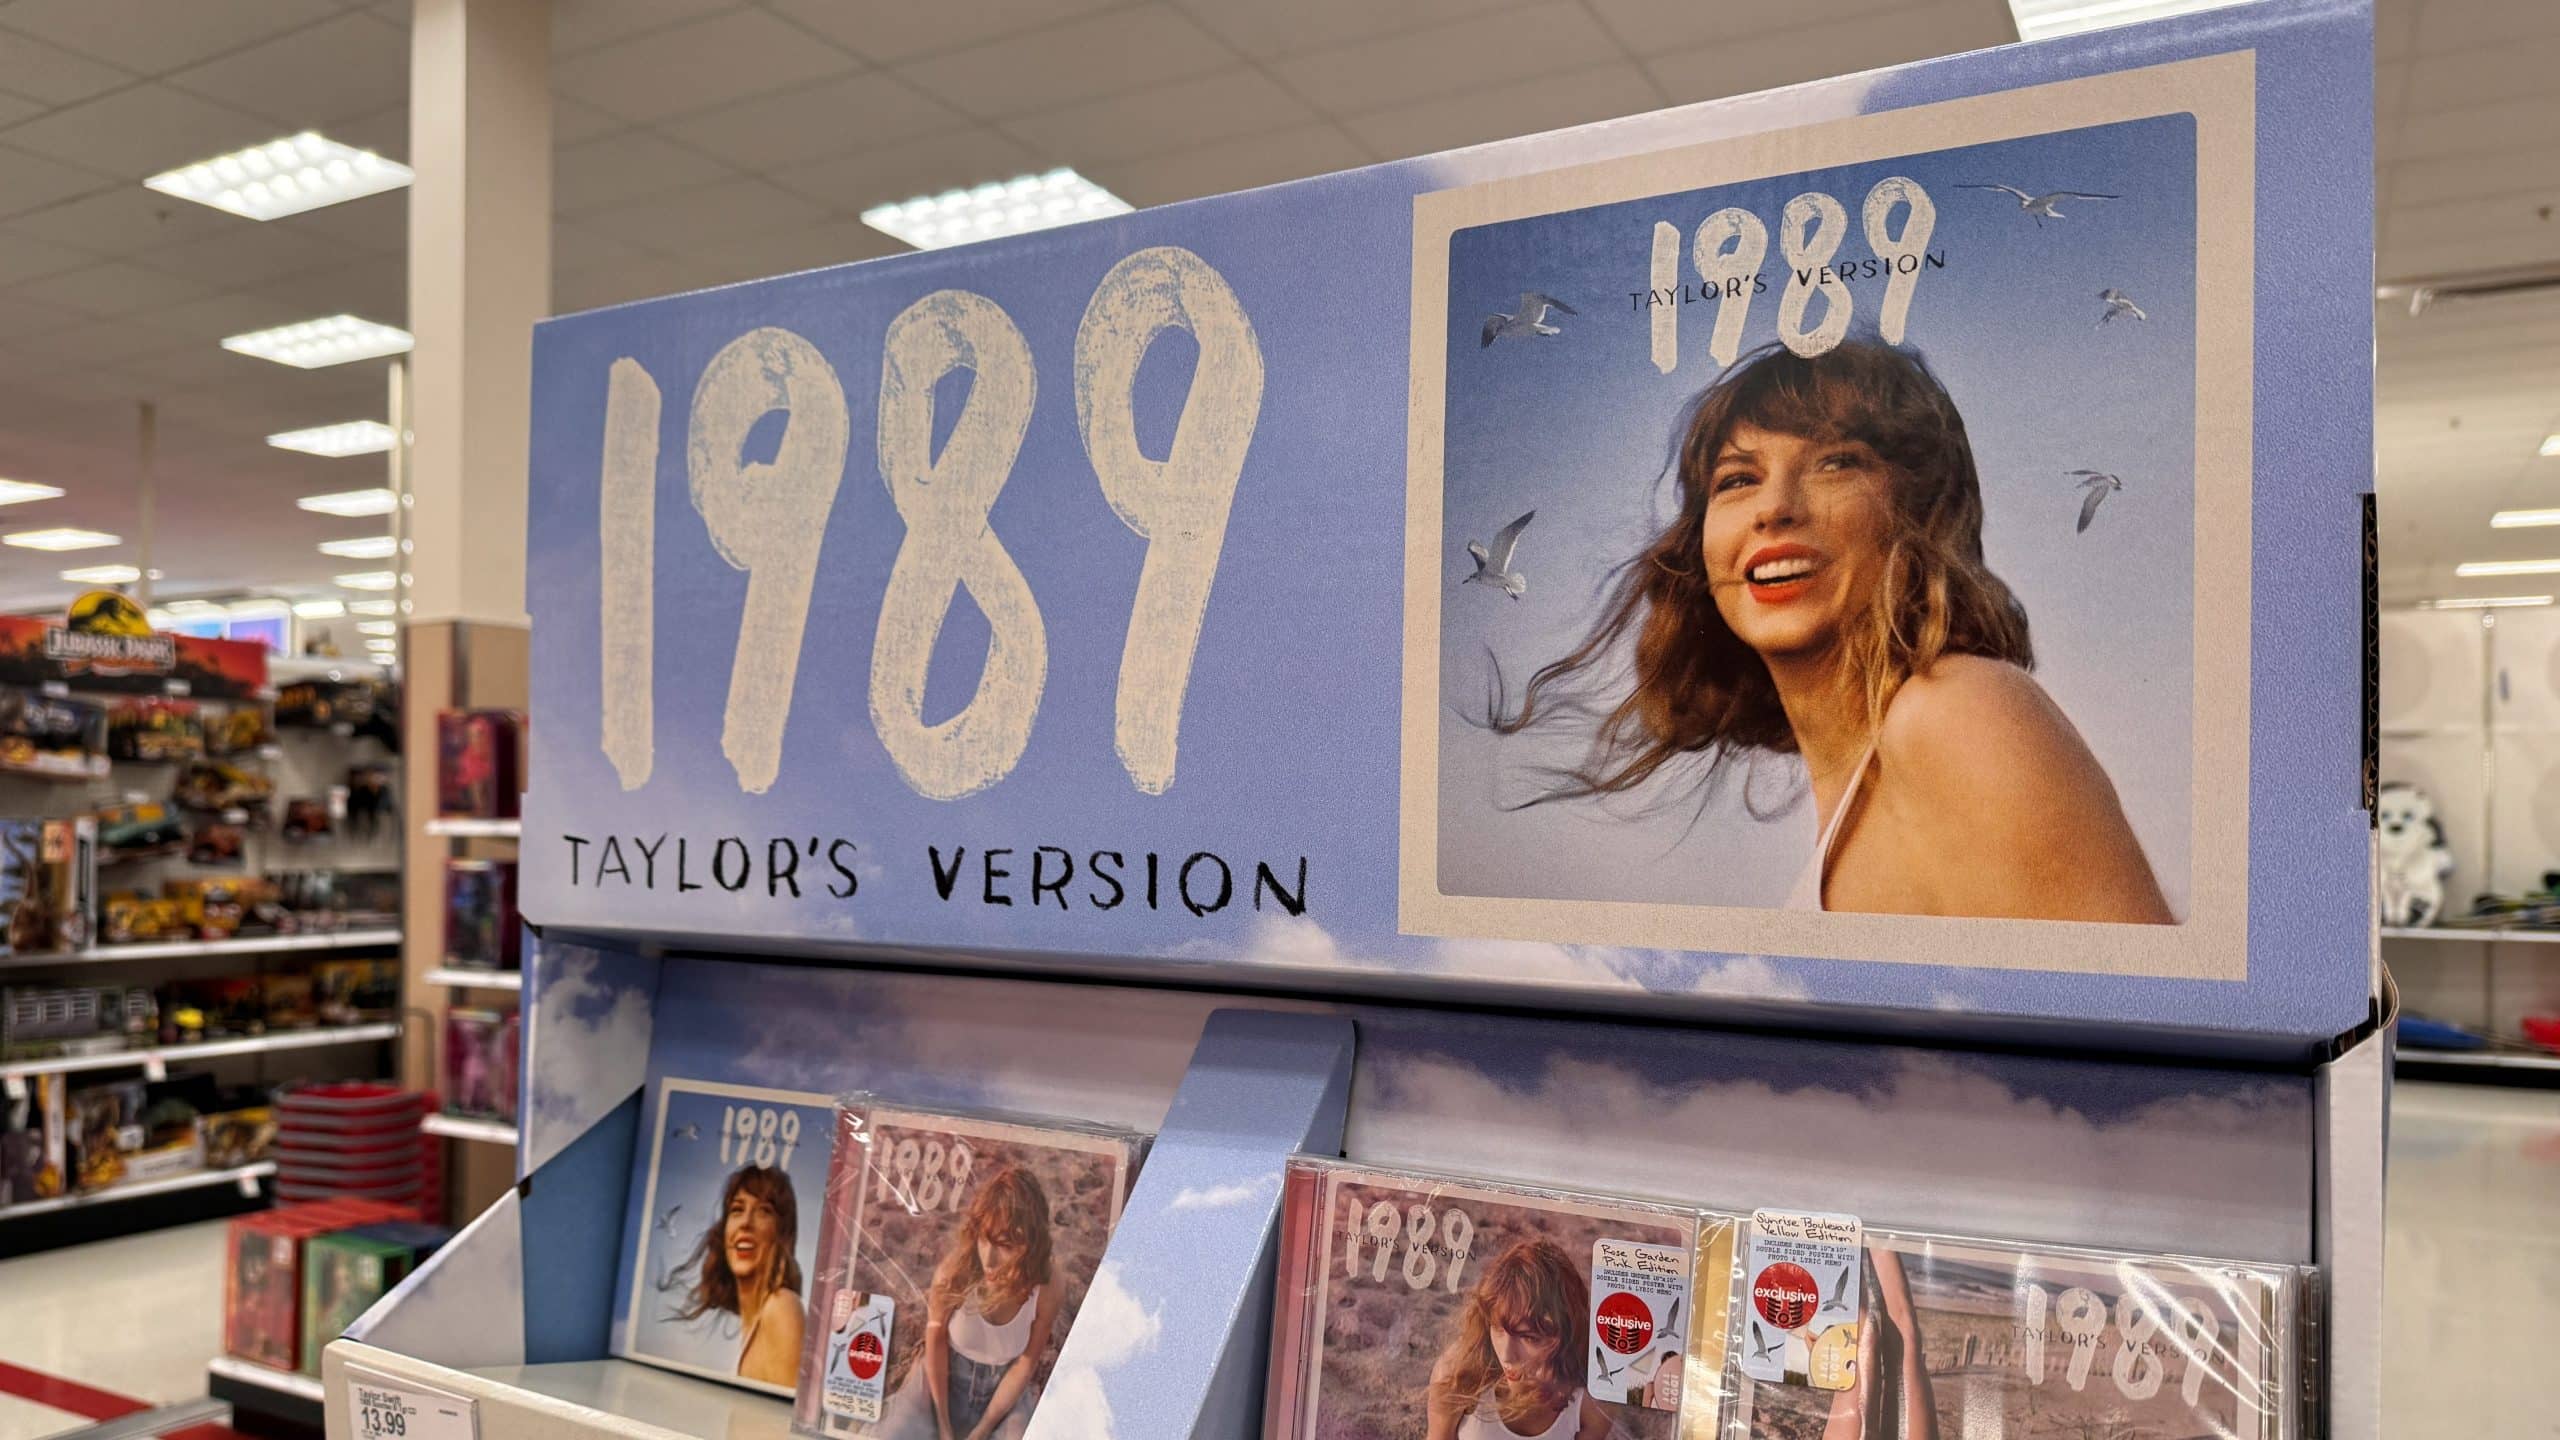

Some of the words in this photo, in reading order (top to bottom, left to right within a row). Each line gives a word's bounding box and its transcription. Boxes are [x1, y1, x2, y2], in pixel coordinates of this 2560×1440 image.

[1629, 273, 1768, 311] TAYLOR'S
[1796, 250, 1945, 286] VERSION
[1650, 176, 1936, 374] 1989
[600, 246, 1264, 801] 1989
[563, 833, 858, 898] TAYLOR'S
[928, 846, 1307, 917] VERSION
[721, 1105, 800, 1171] 1989
[877, 1137, 972, 1213] 1989
[1756, 1212, 1799, 1227] Sunrise
[1800, 1217, 1856, 1232] Boulevard
[1760, 1224, 1799, 1238] Yellow
[1805, 1229, 1853, 1242] Edition
[1337, 1231, 1400, 1249] TAYLOR'S
[1412, 1242, 1476, 1261] VERSION
[1346, 1198, 1474, 1293] 1989
[1601, 1244, 1627, 1257] Rose
[1635, 1249, 1679, 1263] Garden
[1603, 1256, 1632, 1268] Pink
[1637, 1261, 1679, 1275] Edition
[1754, 1286, 1817, 1304] exclusive
[1597, 1315, 1651, 1331] exclusive
[2010, 1326, 2105, 1350] TAYLOR'S
[2126, 1340, 2225, 1364] VERSON
[2026, 1284, 2219, 1408] 1989
[361, 1407, 405, 1436] 13.99
